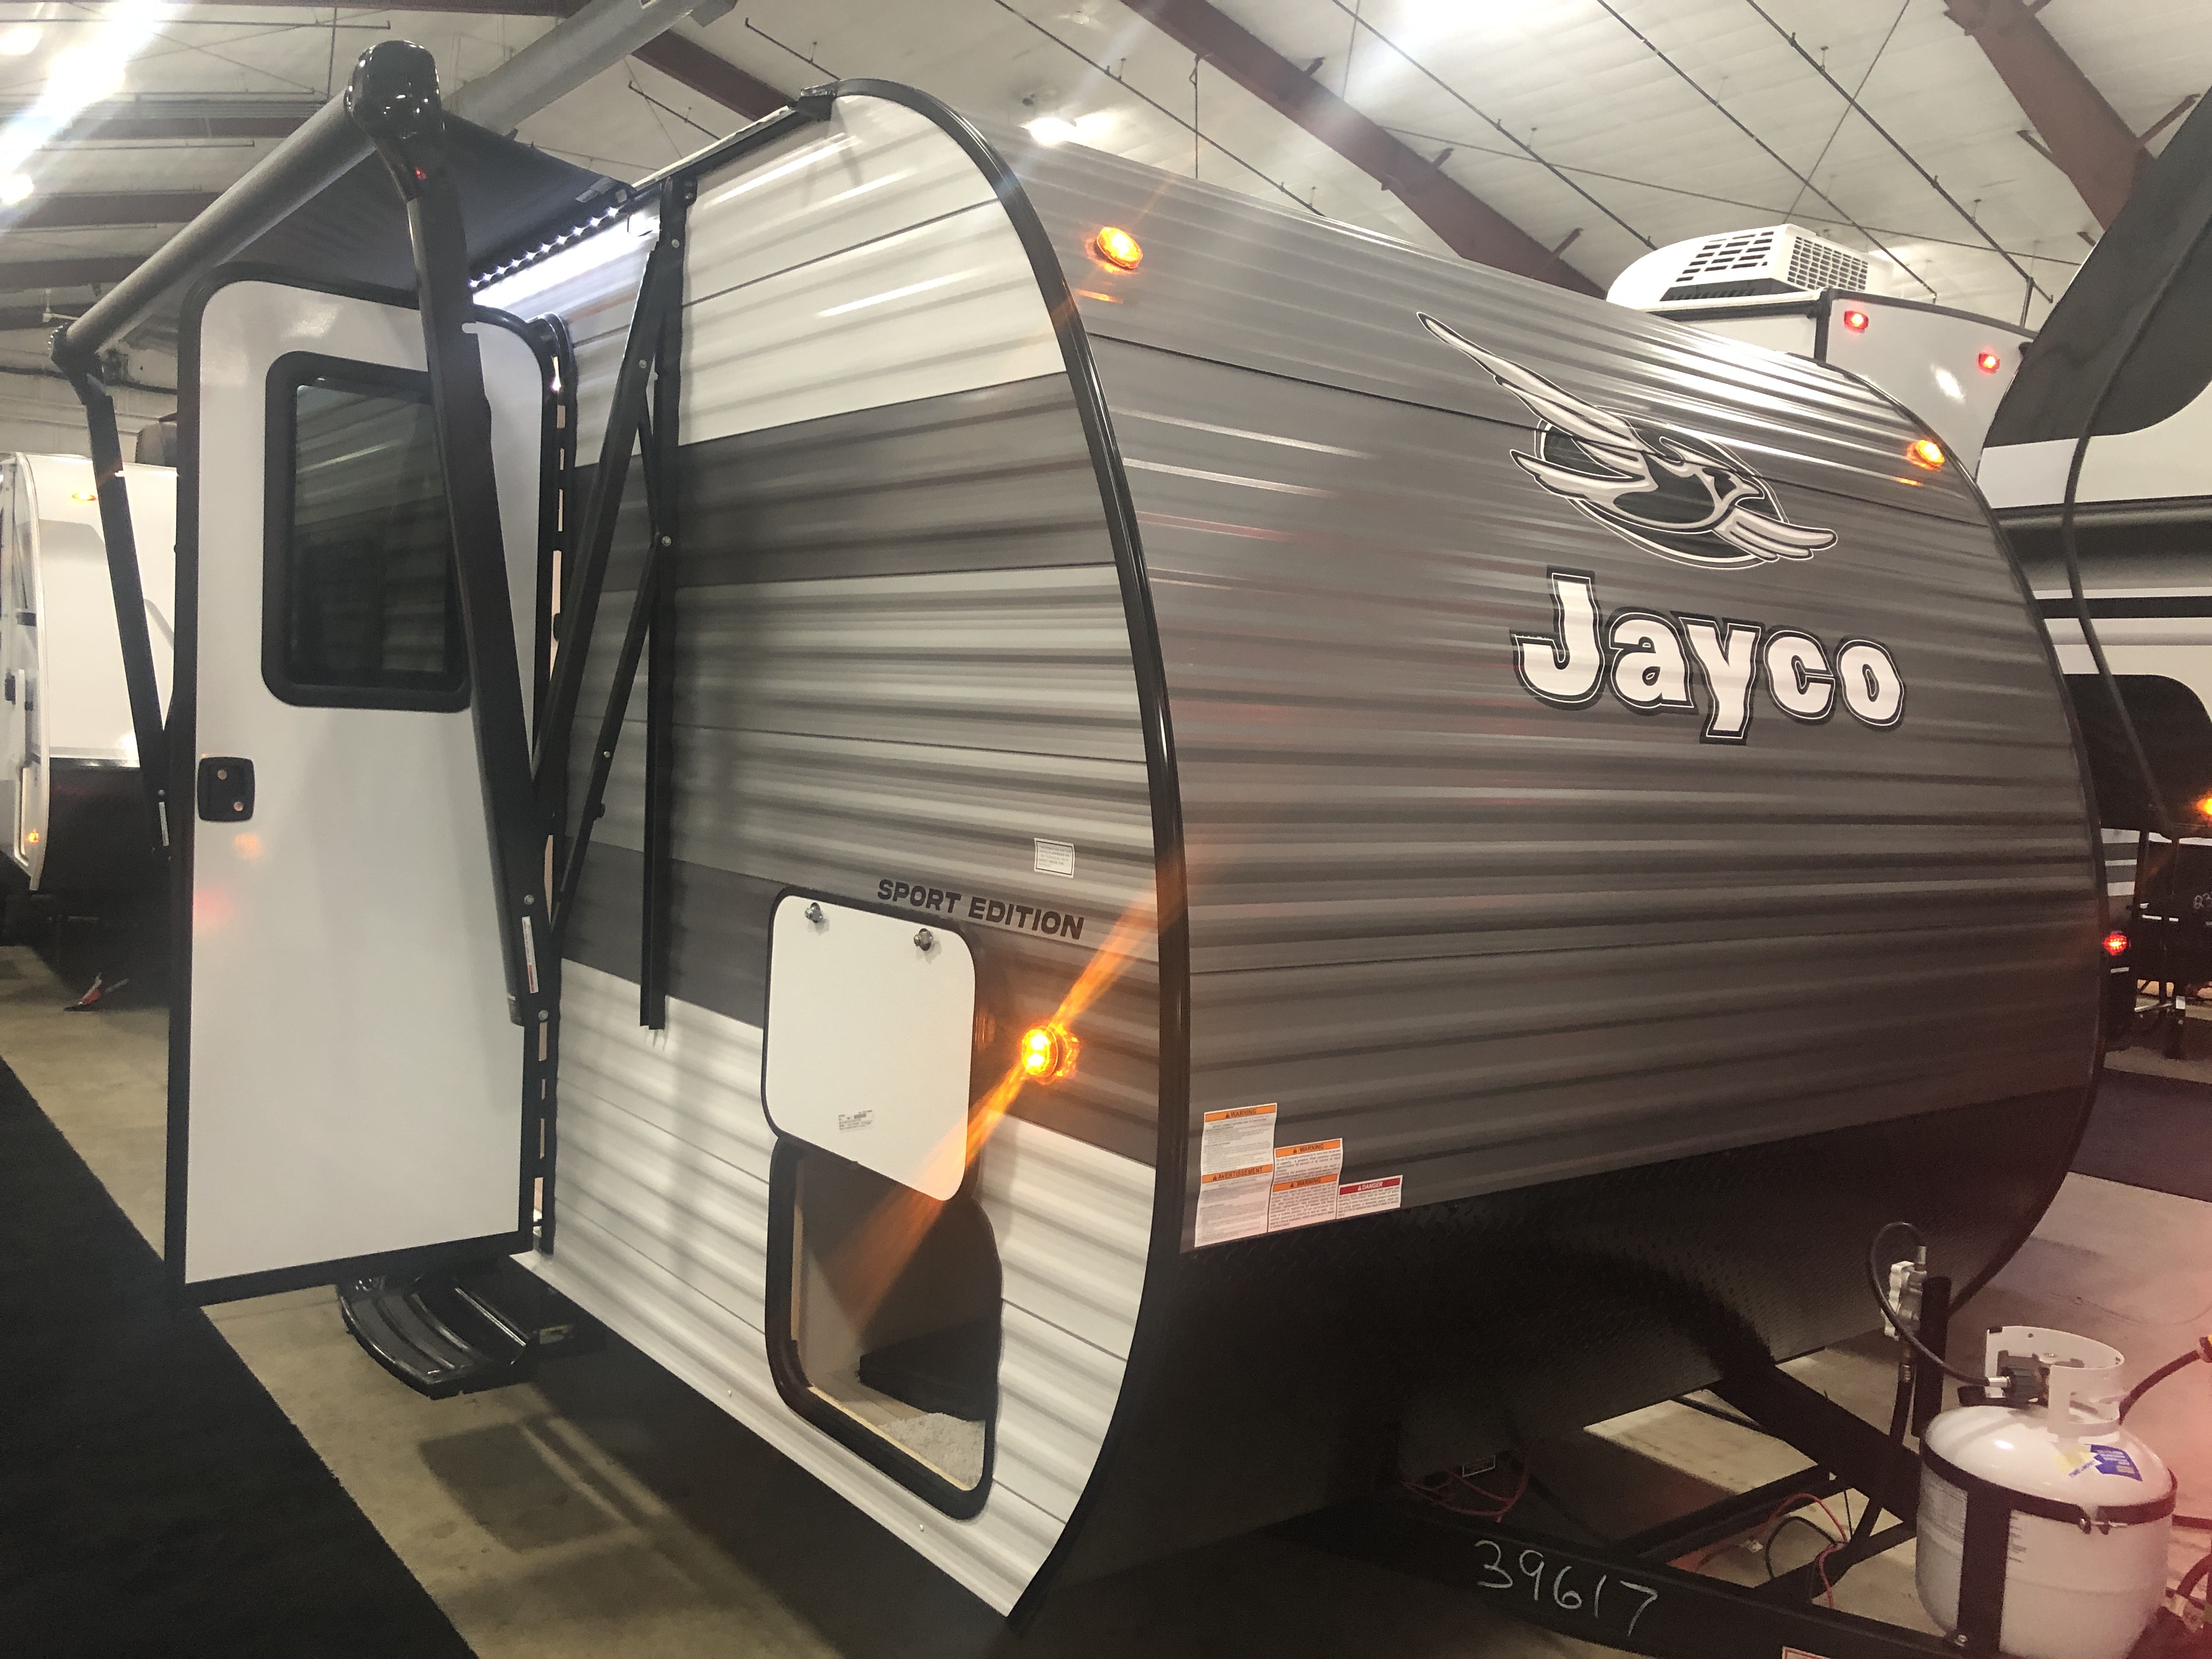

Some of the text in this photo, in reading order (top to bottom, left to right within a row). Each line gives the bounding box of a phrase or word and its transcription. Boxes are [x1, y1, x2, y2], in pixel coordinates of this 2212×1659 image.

[1509, 565, 1906, 744] Jayco
[878, 879, 1084, 940] SPORT EDITION
[1231, 1109, 1257, 1118] WARNING
[1300, 1144, 1324, 1153] WARNING
[1218, 1167, 1263, 1179] AVERTISSEMENT
[1297, 1178, 1321, 1187] WARNING
[1362, 1181, 1383, 1190] DANGER
[1474, 1539, 1658, 1637] 39617
